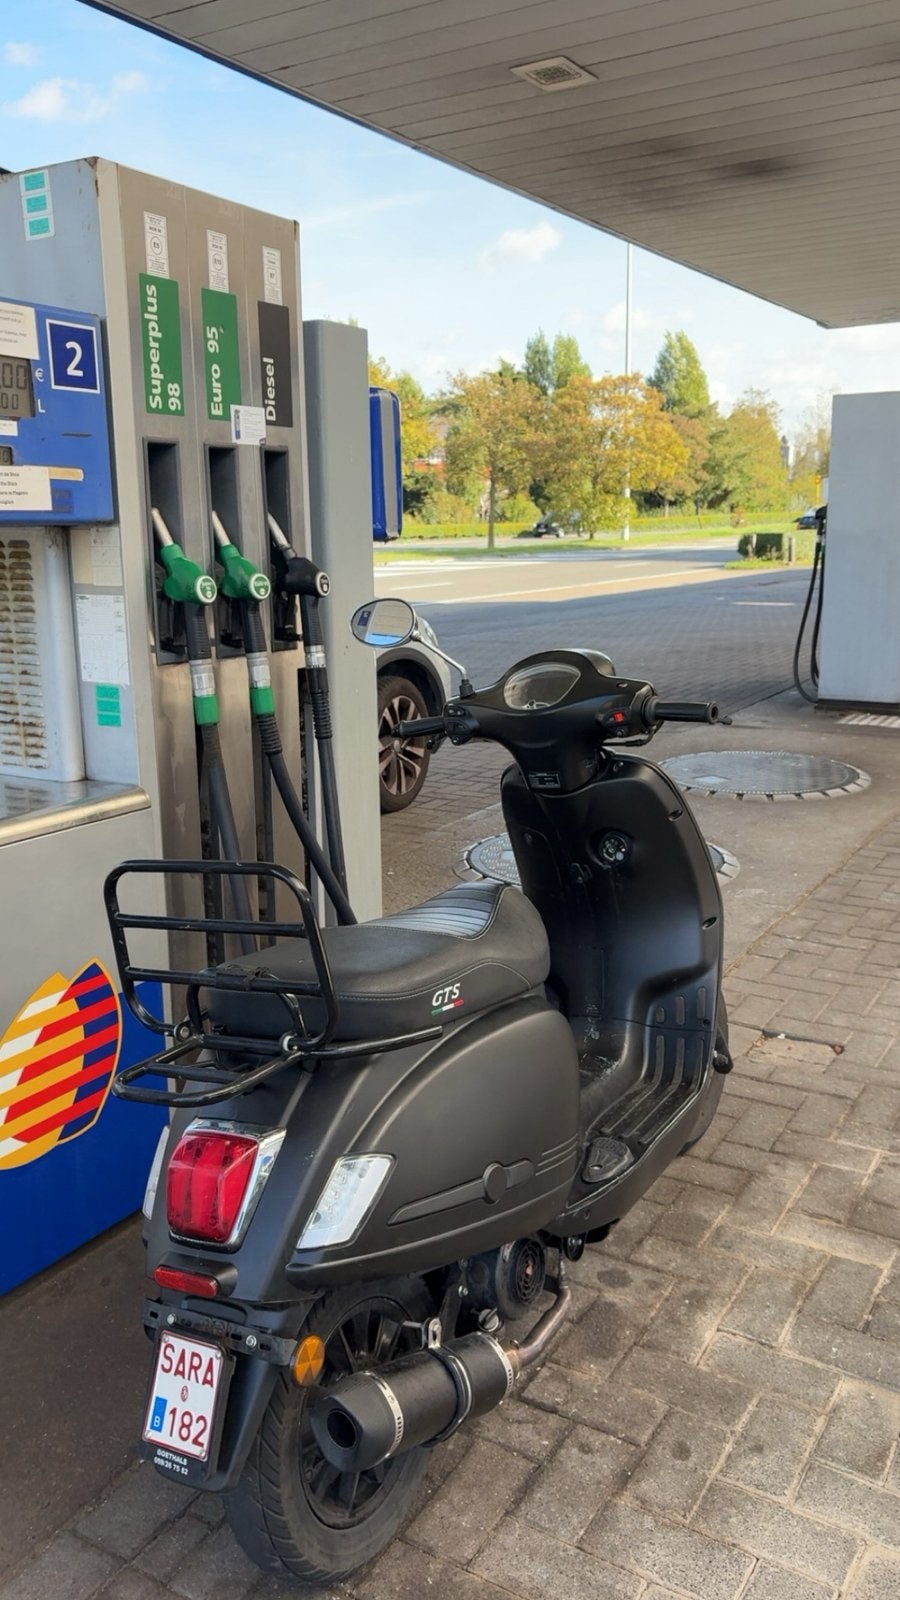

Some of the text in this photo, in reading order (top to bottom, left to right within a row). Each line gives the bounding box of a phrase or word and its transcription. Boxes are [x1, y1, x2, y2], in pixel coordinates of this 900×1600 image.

[65, 341, 84, 377] 2
[144, 284, 164, 409] Superplus
[35, 368, 44, 382] €
[206, 326, 223, 416] Euro 95
[262, 357, 276, 421] Diesel
[38, 398, 46, 414] L
[167, 382, 182, 411] 98
[431, 982, 461, 1007] GTS
[160, 1343, 214, 1388] SARA
[153, 1415, 161, 1428] B
[169, 1407, 208, 1447] 182
